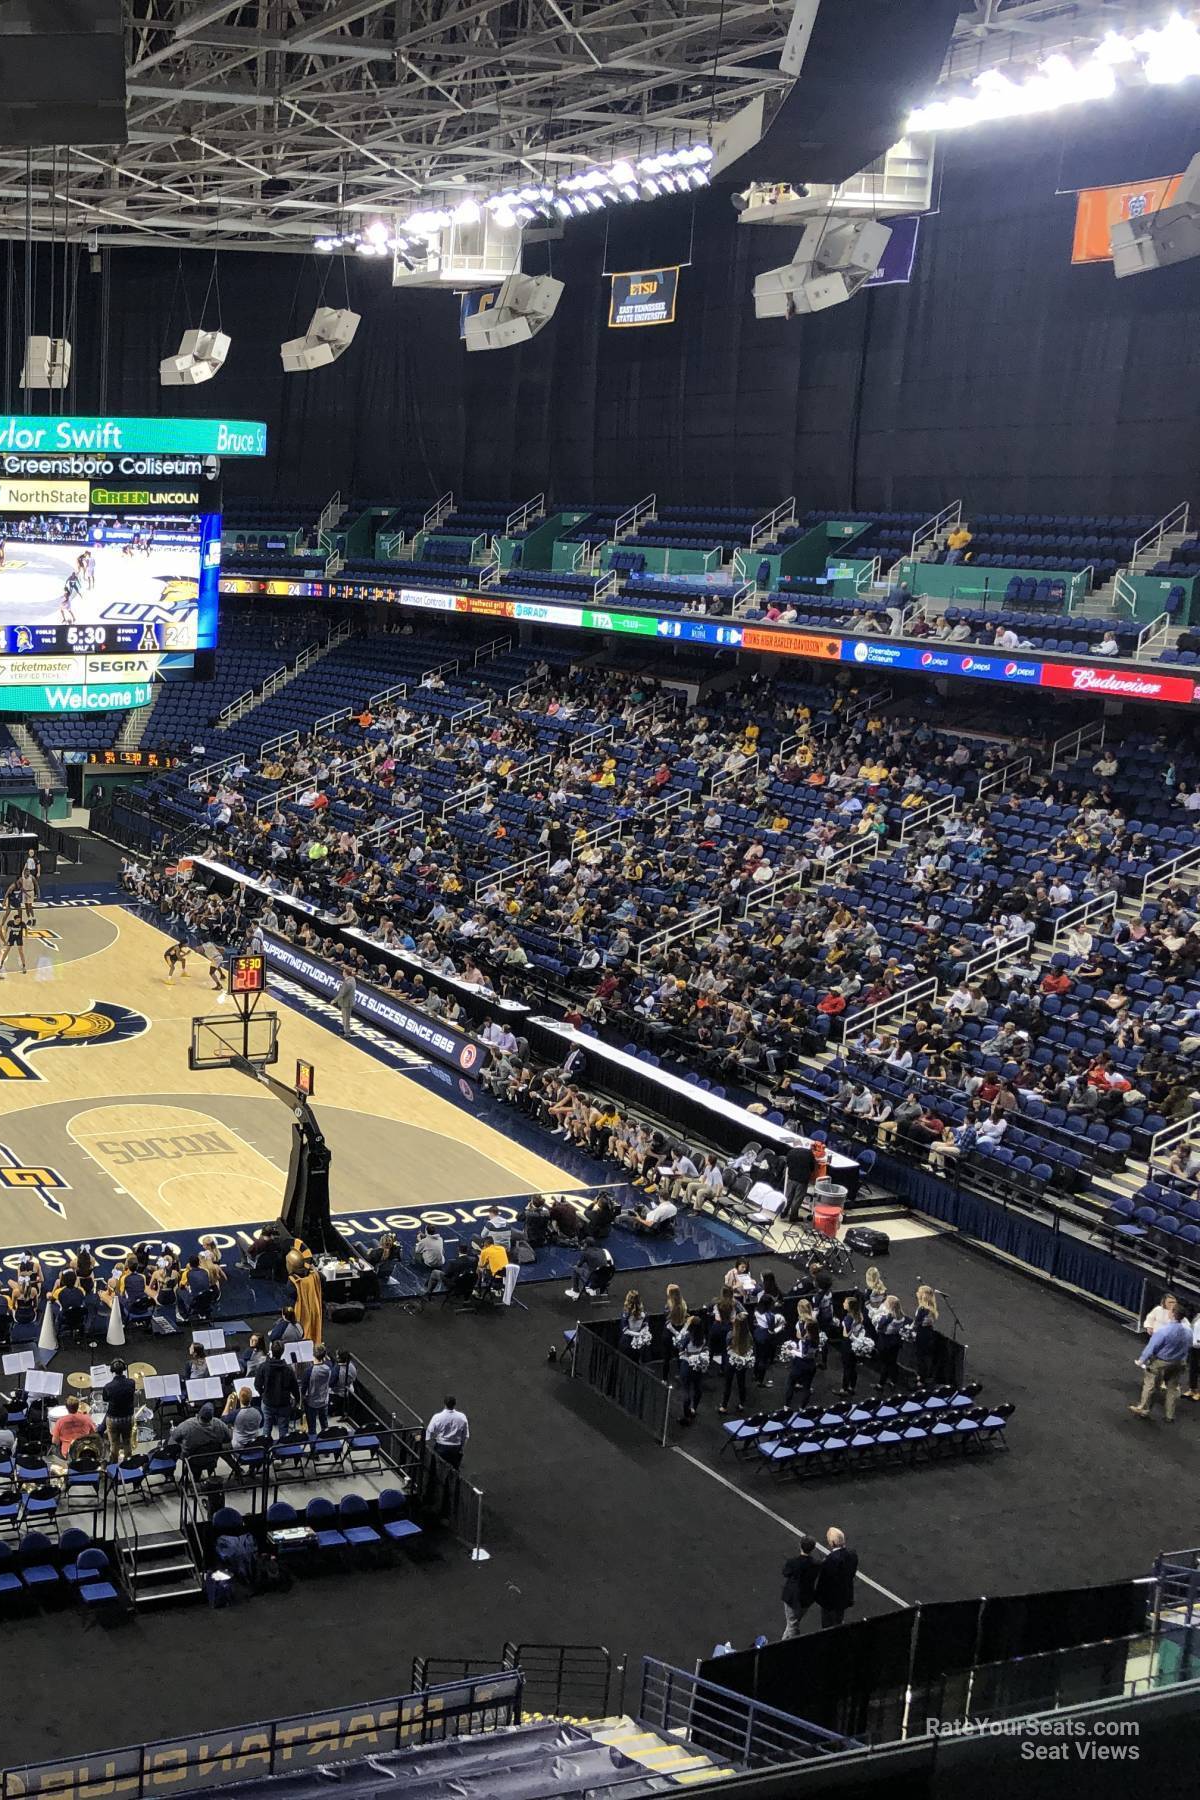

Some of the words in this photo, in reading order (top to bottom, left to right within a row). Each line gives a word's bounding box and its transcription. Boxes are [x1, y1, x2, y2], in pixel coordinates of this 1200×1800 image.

[630, 281, 657, 295] ETSU
[619, 305, 633, 314] EAST
[635, 302, 666, 313] TENNESSEE
[616, 314, 633, 323] STATE
[635, 311, 667, 322] UNIVERSITY
[56, 422, 123, 449] Swift
[217, 424, 253, 452] Bruce
[4, 456, 113, 475] Greensboro
[119, 456, 202, 475] Coliseum
[8, 489, 87, 504] NorthState
[92, 489, 149, 505] GREEN
[150, 493, 199, 504] LINCOLN
[224, 582, 238, 593] 24
[288, 585, 300, 596] 24
[402, 592, 423, 605] Johnson
[424, 595, 446, 607] Controls
[523, 606, 548, 618] BRADY
[592, 612, 613, 629] TFA
[623, 620, 639, 629] CLUB
[67, 627, 106, 644] 5:30
[165, 627, 189, 646] 24
[868, 647, 901, 657] Greensboro
[868, 654, 893, 663] Coliseum
[932, 658, 949, 666] pepsi
[10, 661, 72, 672] ticketmaster
[88, 661, 148, 672] SEGRA
[973, 663, 990, 671] pepsi
[1017, 668, 1035, 677] pepsi
[1071, 669, 1162, 695] Budweiser
[45, 686, 131, 710] Welcome
[135, 688, 145, 704] to
[90, 753, 96, 764] 3
[125, 752, 142, 761] 5:30
[239, 958, 261, 969] 5:30
[237, 970, 258, 988] 20
[263, 941, 302, 970] SUPPORTING
[367, 998, 407, 1028] SUCCESS
[405, 1018, 434, 1041] SINCE
[431, 1033, 456, 1053] 1986
